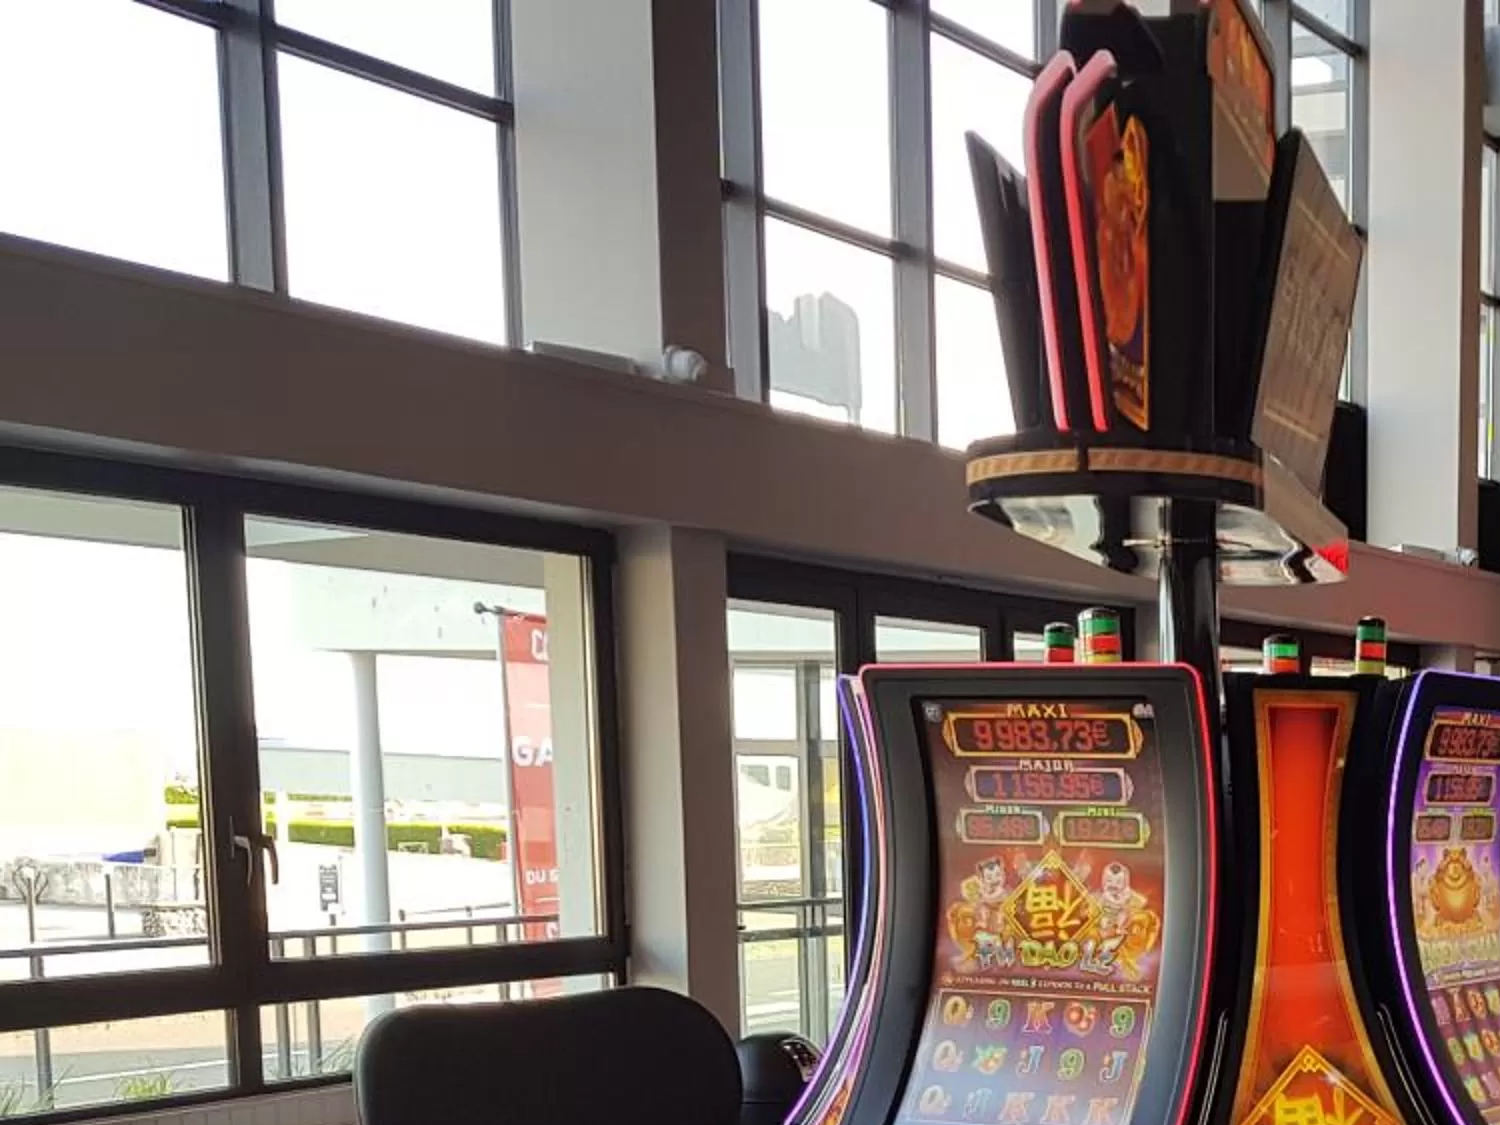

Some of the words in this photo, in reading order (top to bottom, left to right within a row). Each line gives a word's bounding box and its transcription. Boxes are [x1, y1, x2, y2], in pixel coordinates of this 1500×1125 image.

[1007, 703, 1070, 718] MAXI
[1018, 759, 1075, 773] MAJOR
[1019, 939, 1080, 969] DAO
